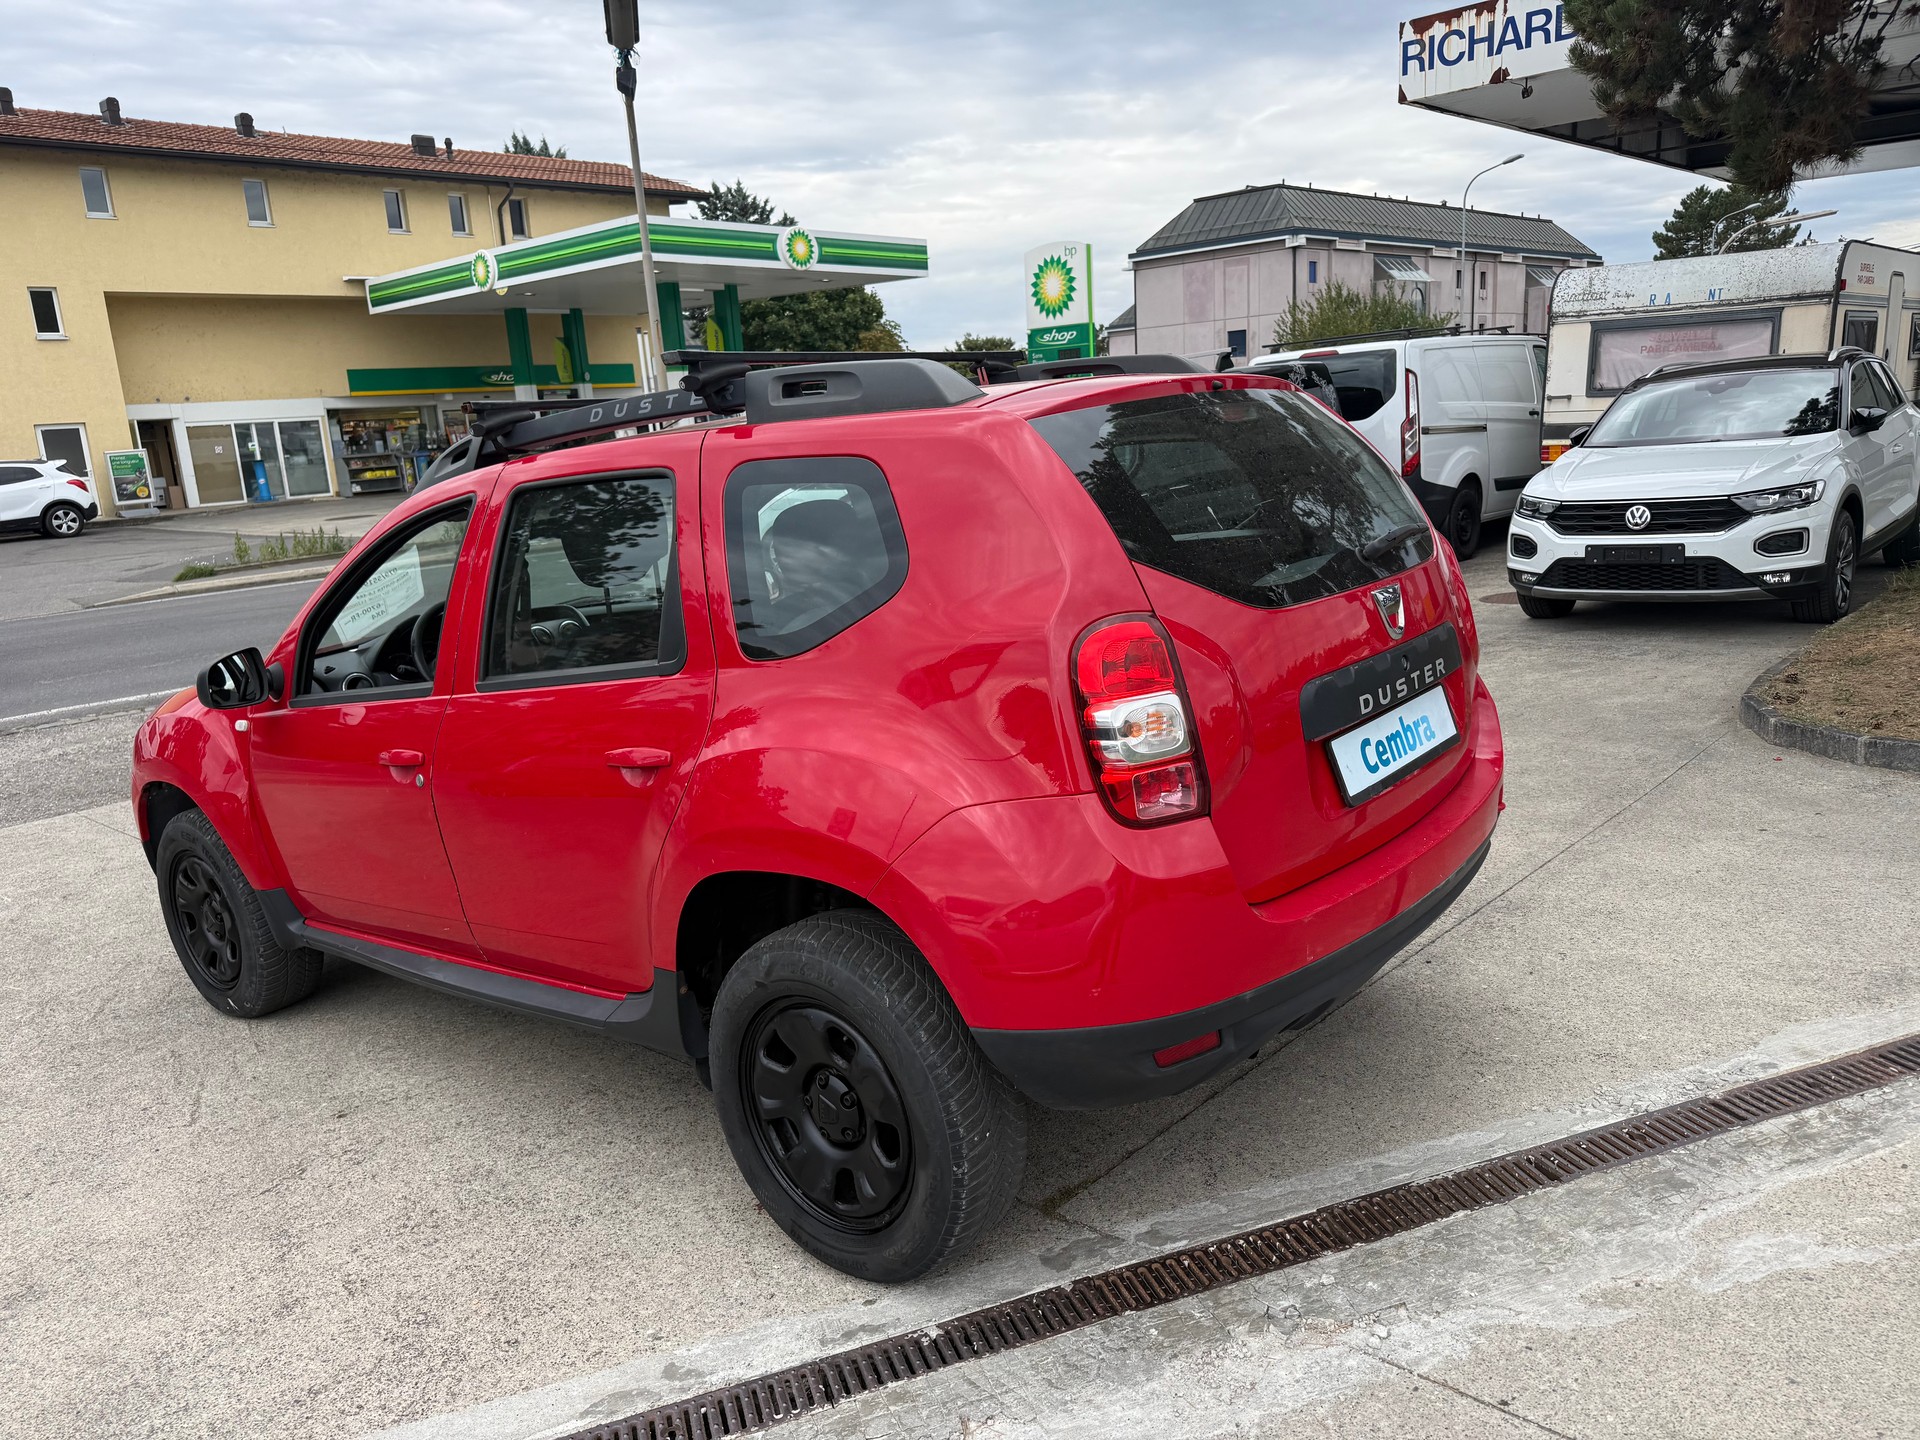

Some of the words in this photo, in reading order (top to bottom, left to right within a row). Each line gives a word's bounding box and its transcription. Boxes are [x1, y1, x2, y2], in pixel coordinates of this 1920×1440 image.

[1064, 245, 1077, 259] bp
[1043, 329, 1077, 342] shop
[490, 371, 515, 382] sho
[1359, 657, 1446, 715] DUSTER
[1360, 714, 1436, 774] Cembra
